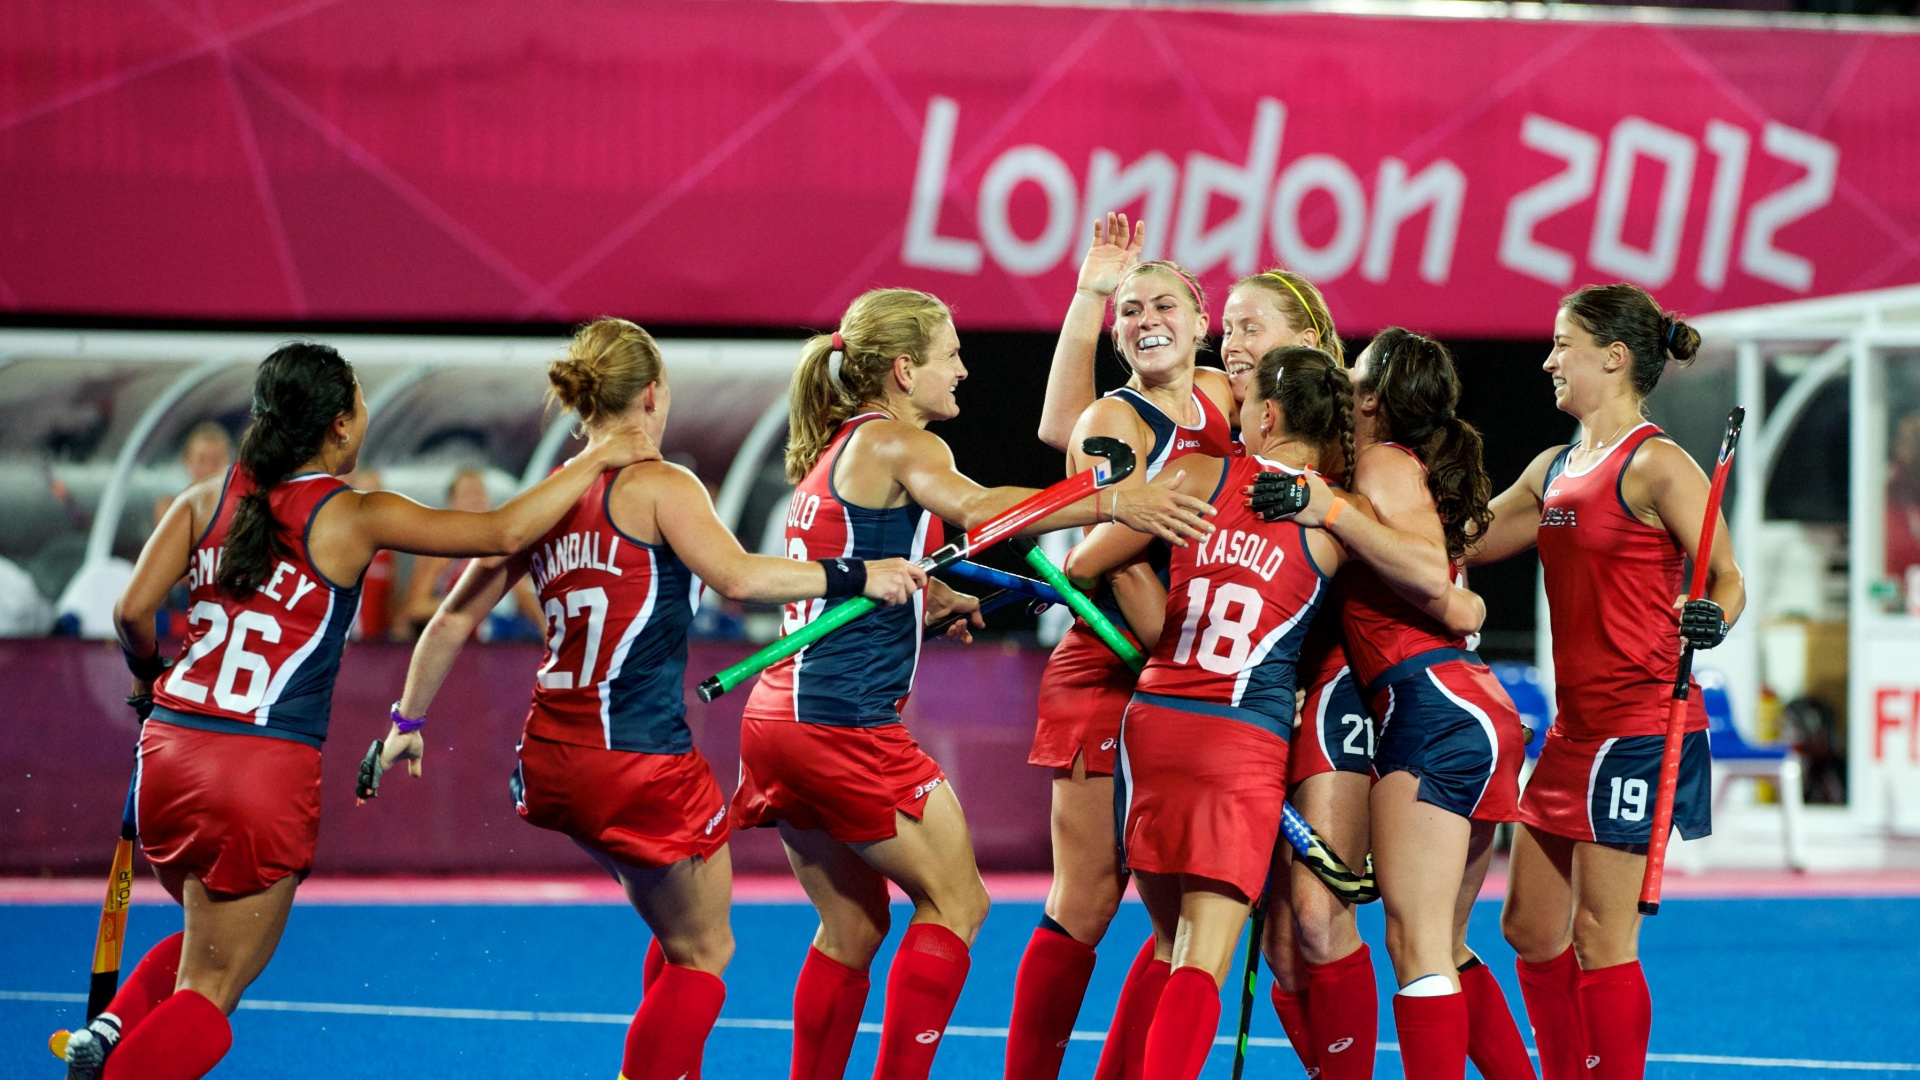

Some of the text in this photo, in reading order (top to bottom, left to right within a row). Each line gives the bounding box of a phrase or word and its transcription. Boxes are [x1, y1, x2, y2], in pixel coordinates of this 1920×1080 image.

[903, 95, 1840, 293] London 2012
[1196, 529, 1285, 582] KASOLD
[164, 600, 282, 714] 26
[537, 587, 609, 690] 27
[1173, 577, 1264, 675] 18
[1341, 713, 1375, 756] 21
[1608, 776, 1648, 821] 19
[119, 871, 131, 909] TOUR
